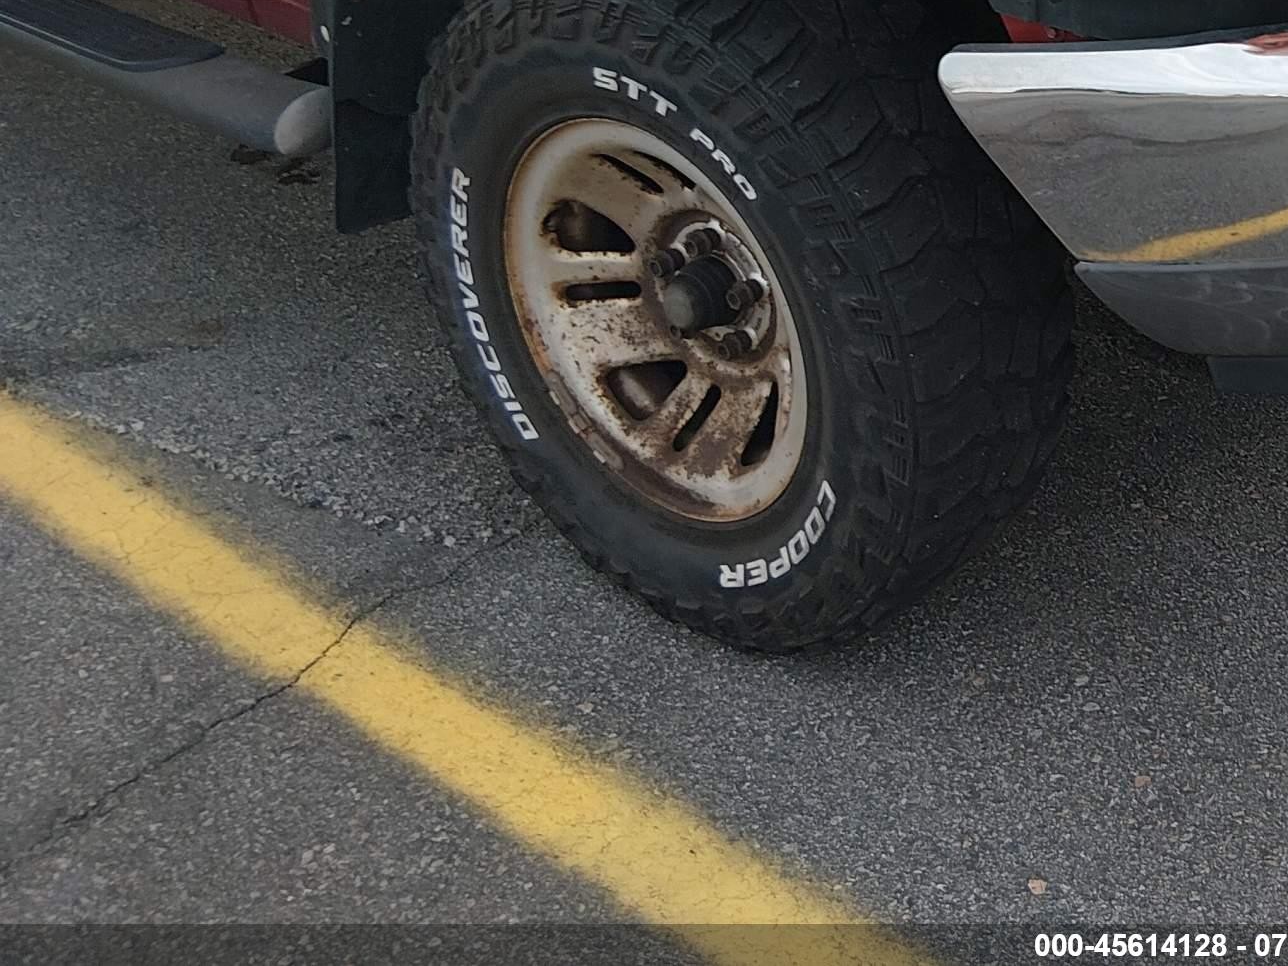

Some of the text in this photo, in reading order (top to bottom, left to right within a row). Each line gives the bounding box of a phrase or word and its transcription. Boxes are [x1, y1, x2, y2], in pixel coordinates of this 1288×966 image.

[592, 66, 758, 202] STT PRO
[451, 167, 540, 441] DISCOVERER
[719, 480, 837, 588] COOPER
